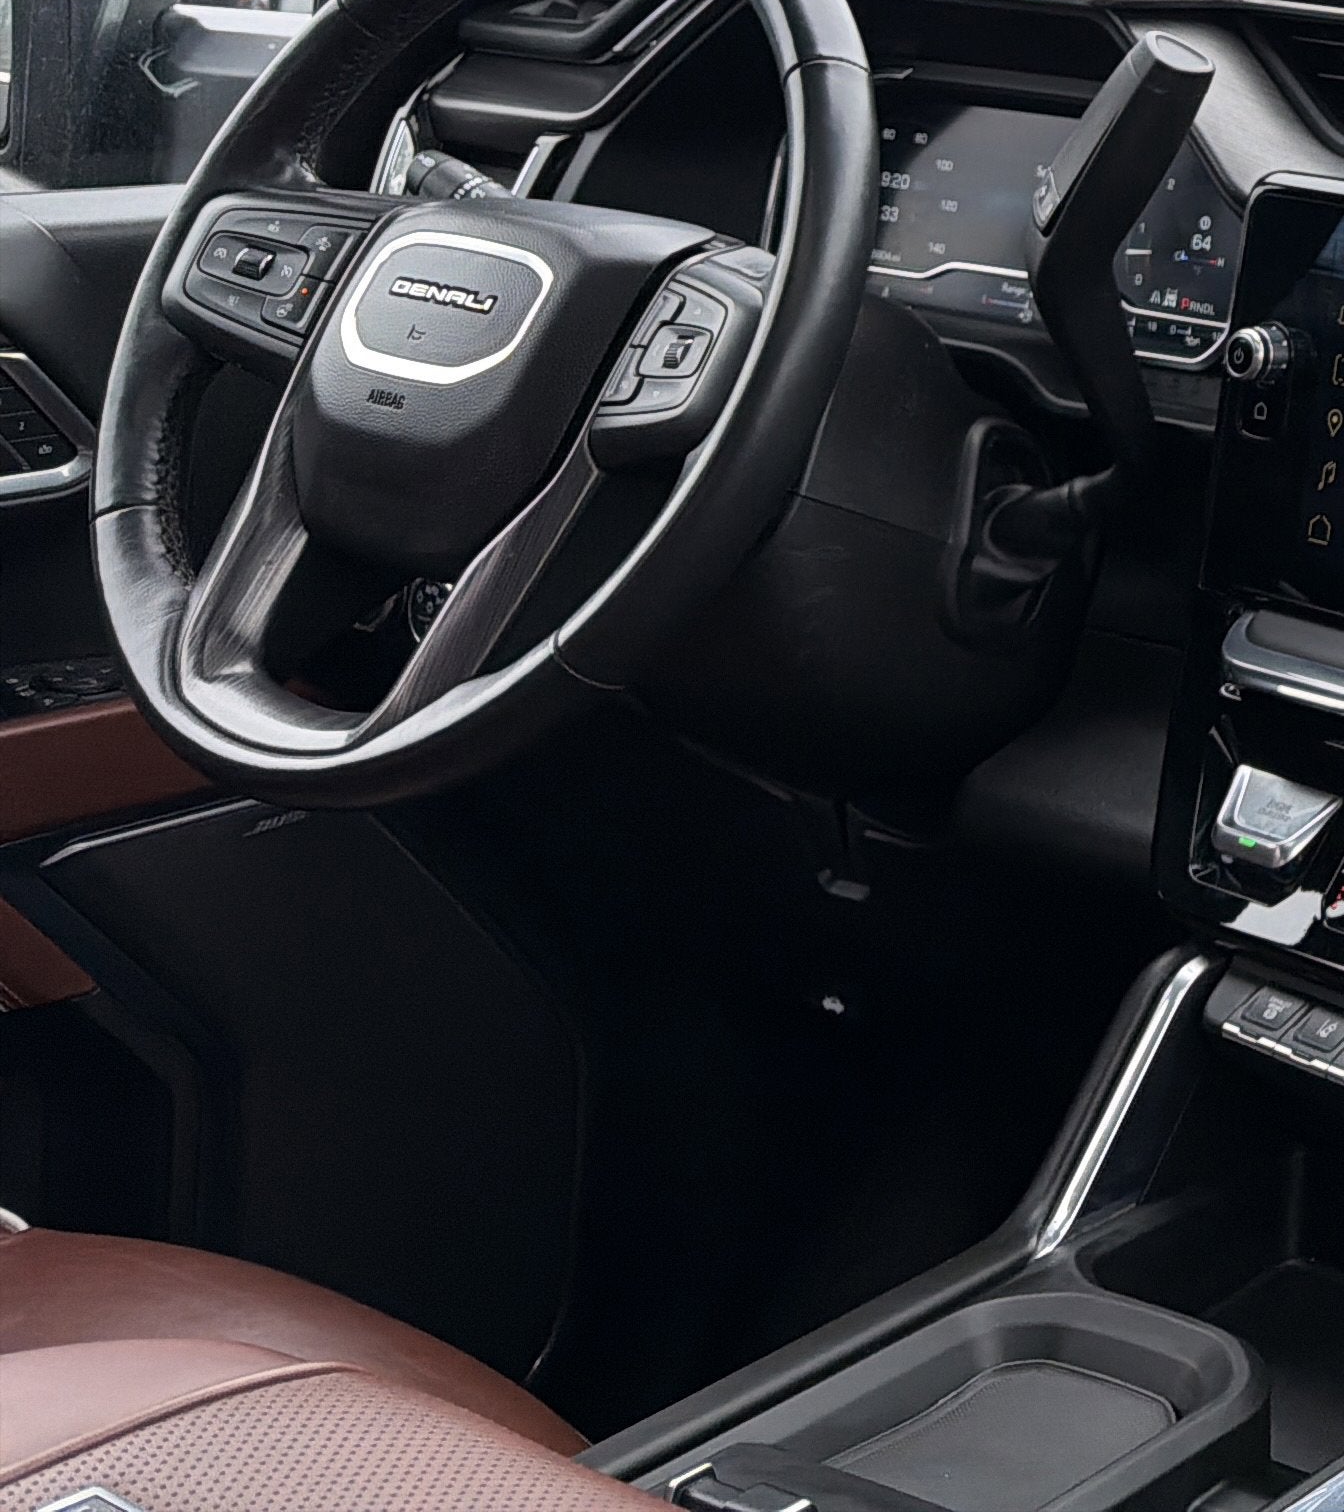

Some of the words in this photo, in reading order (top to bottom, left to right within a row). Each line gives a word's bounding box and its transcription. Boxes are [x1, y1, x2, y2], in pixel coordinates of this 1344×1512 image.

[1191, 234, 1212, 252] 64
[390, 279, 494, 311] DENALI
[367, 388, 406, 409] AIRBAG
